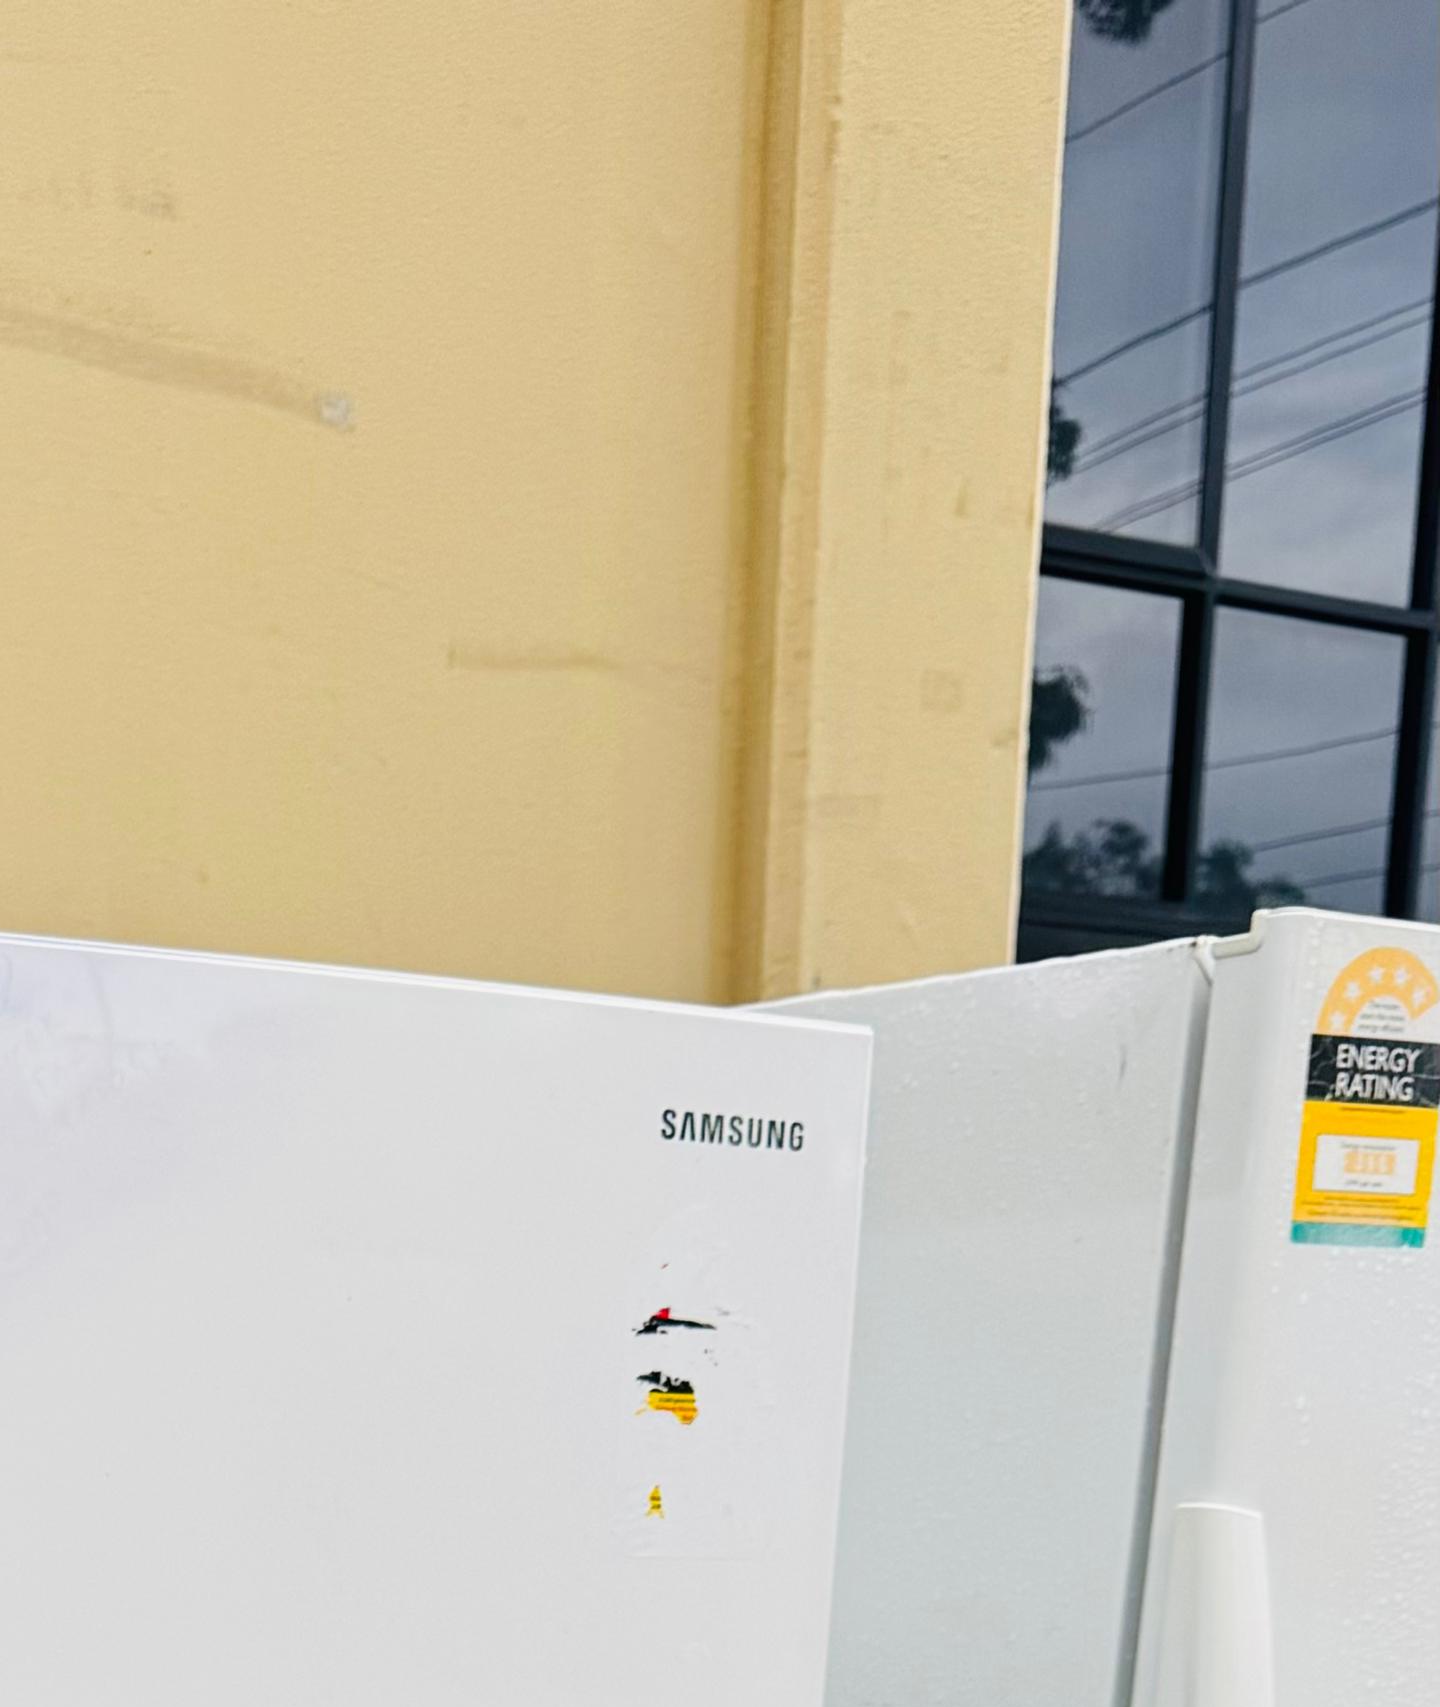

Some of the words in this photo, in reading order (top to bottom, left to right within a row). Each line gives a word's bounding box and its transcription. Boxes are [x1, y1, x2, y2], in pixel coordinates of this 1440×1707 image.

[1337, 1043, 1420, 1073] ENERGY
[1334, 1073, 1415, 1101] RATING
[661, 1109, 805, 1151] SAMSUNG
